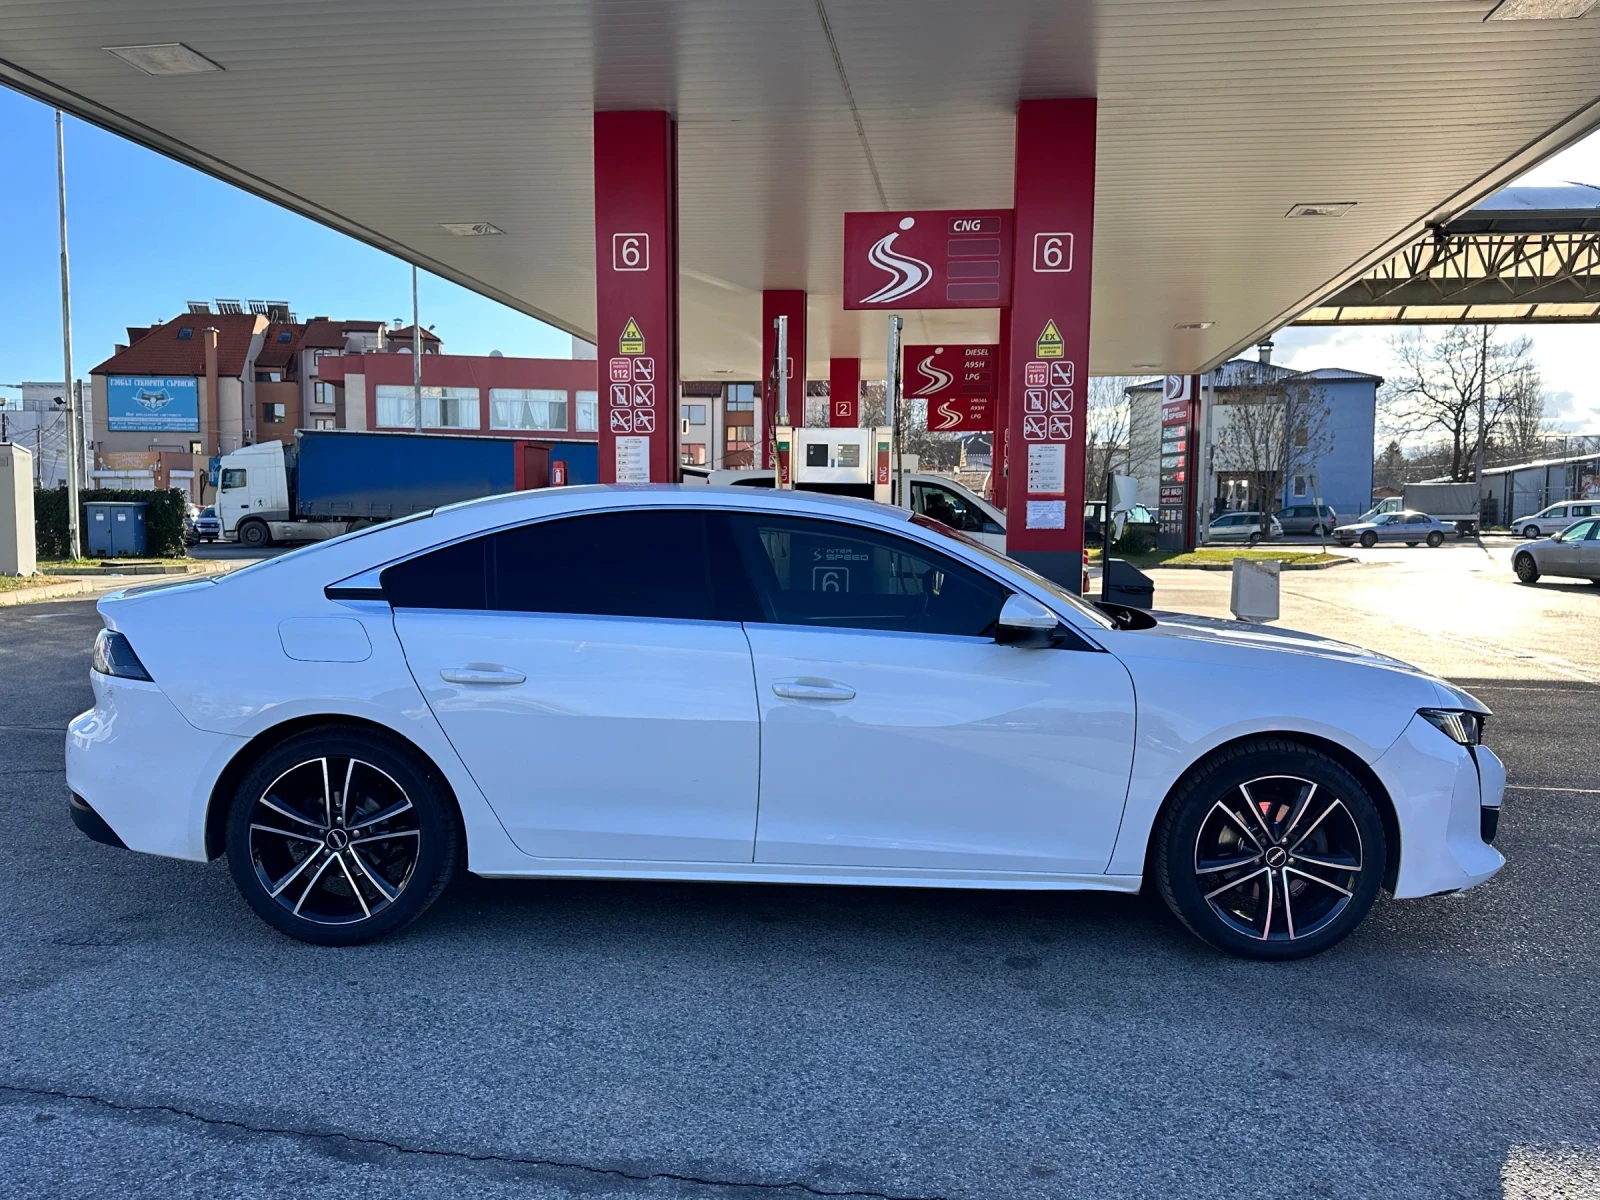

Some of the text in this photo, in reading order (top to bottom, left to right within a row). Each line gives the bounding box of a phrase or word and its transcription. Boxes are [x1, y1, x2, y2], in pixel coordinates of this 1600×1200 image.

[954, 220, 981, 232] CNG
[622, 238, 640, 266] 6
[1044, 238, 1062, 267] 6
[613, 370, 628, 378] 112
[1028, 374, 1045, 383] 112
[110, 378, 132, 386] ГЛОБАЛ
[840, 404, 847, 414] 2
[879, 467, 887, 482] CNG
[1162, 488, 1170, 496] CAR
